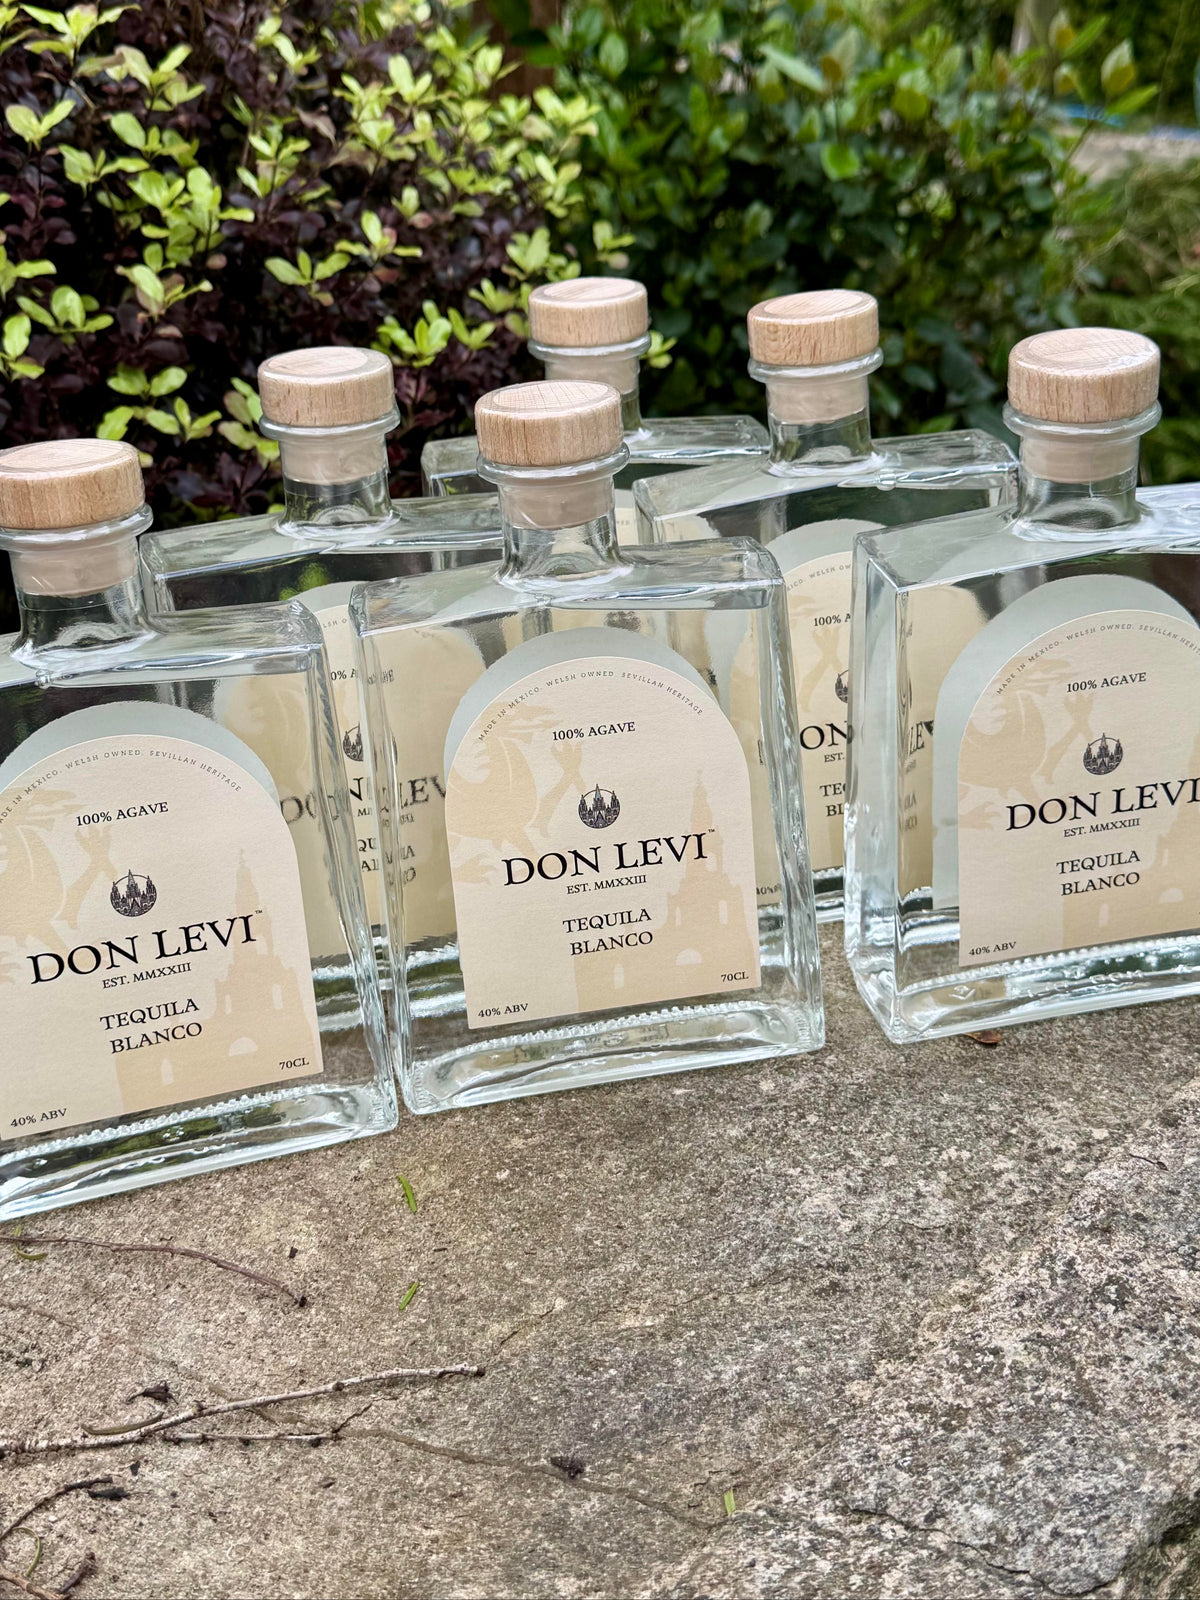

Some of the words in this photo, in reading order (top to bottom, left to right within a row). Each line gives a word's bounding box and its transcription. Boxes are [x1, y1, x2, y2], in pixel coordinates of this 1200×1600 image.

[814, 614, 841, 627] 100%
[996, 673, 1016, 695] MADE
[1016, 664, 1026, 673] IN
[1066, 627, 1096, 641] WELSH
[1139, 624, 1178, 639] SEVILLAN
[1067, 679, 1097, 693] 100%
[1100, 671, 1147, 688] AGAVE
[478, 719, 497, 741] MADE
[497, 708, 507, 719] IN
[546, 673, 576, 687] WELSH
[621, 672, 664, 688] SEVILLAN
[666, 686, 704, 715] HERITAGE
[552, 727, 585, 741] 100%
[588, 721, 636, 737] AGAVE
[800, 720, 848, 750] ON
[824, 752, 846, 763] EST.
[12, 795, 23, 805] IN
[65, 754, 99, 769] WELSH
[149, 750, 197, 766] SEVILLAN
[199, 763, 242, 793] HERITAGE
[75, 810, 113, 827] 100%
[116, 801, 169, 821] AGAVE
[1005, 791, 1102, 832] DON
[1063, 826, 1087, 838] EST.
[1089, 817, 1141, 835] MMXXIII
[501, 845, 602, 887] DON
[1055, 850, 1141, 875] TEQUILA
[566, 882, 592, 895] EST.
[593, 874, 647, 891] MMXXIII
[1060, 871, 1141, 897] BLANCO
[562, 908, 652, 934] TEQUILA
[570, 930, 654, 956] BLANCO
[968, 945, 990, 957] 40%
[993, 941, 1017, 954] ABV
[26, 934, 140, 985] DON
[102, 975, 130, 990] EST.
[133, 962, 192, 984] MMXXIII
[720, 970, 750, 983] 70CL
[99, 997, 200, 1031] TEQUILA
[478, 1006, 501, 1019] 40%
[504, 1002, 529, 1014] ABV
[110, 1021, 203, 1055] BLANCO
[279, 1056, 310, 1071] 70CL
[10, 1113, 37, 1128] 40%
[40, 1107, 68, 1123] ABV
